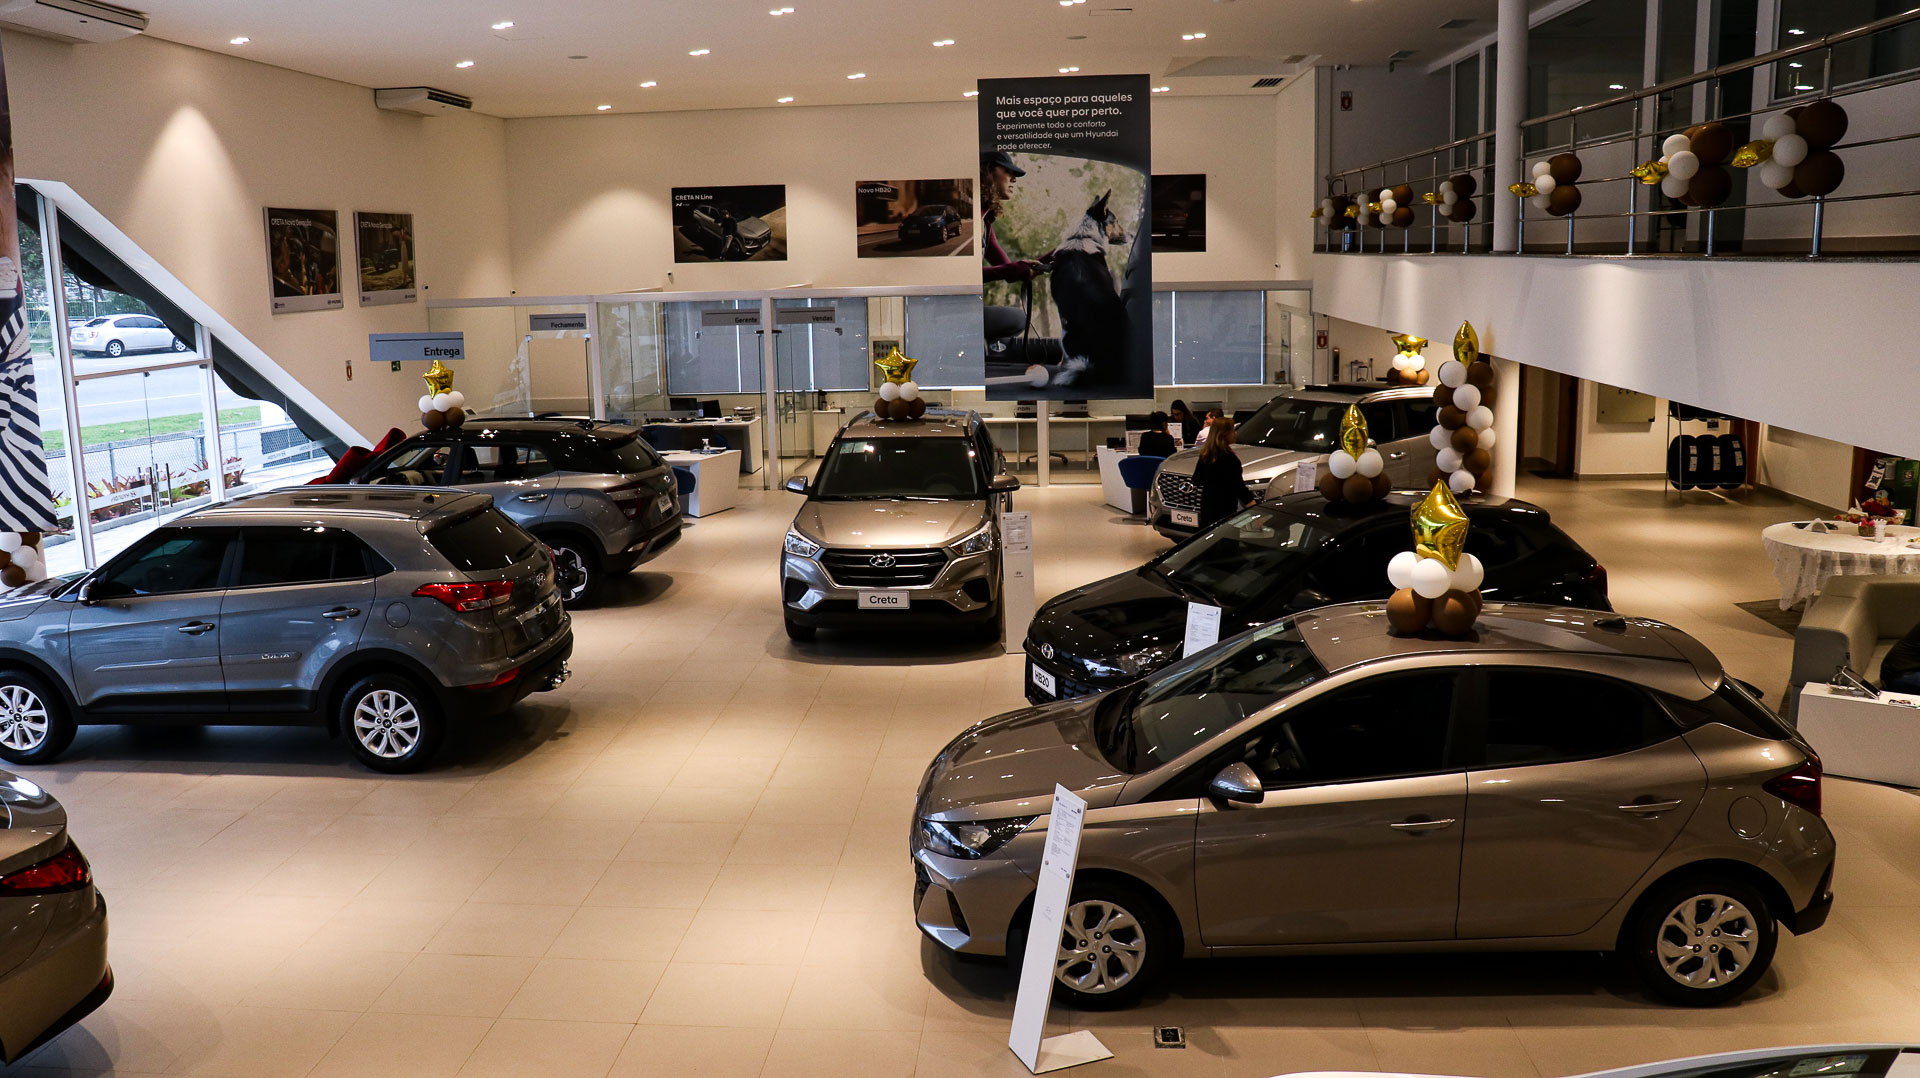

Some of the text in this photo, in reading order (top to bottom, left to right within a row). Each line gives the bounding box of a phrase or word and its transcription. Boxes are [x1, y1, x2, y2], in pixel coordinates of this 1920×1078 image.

[996, 92, 1133, 106] Mais espaço para aqueles
[996, 106, 1122, 120] que você quer por perto.
[996, 122, 1045, 131] Experimente
[1046, 121, 1065, 129] todo
[1073, 120, 1106, 128] conforto
[1003, 131, 1053, 140] versatilidade
[1054, 132, 1070, 140] que
[1085, 129, 1119, 139] Hyundai
[997, 142, 1052, 151] pode oferecer.
[550, 321, 585, 329] Fechamento
[735, 316, 758, 324] Gerente
[424, 346, 460, 358] Entrega
[1176, 513, 1193, 523] Creta
[869, 595, 898, 605] Creta
[1034, 669, 1050, 688] HB20
